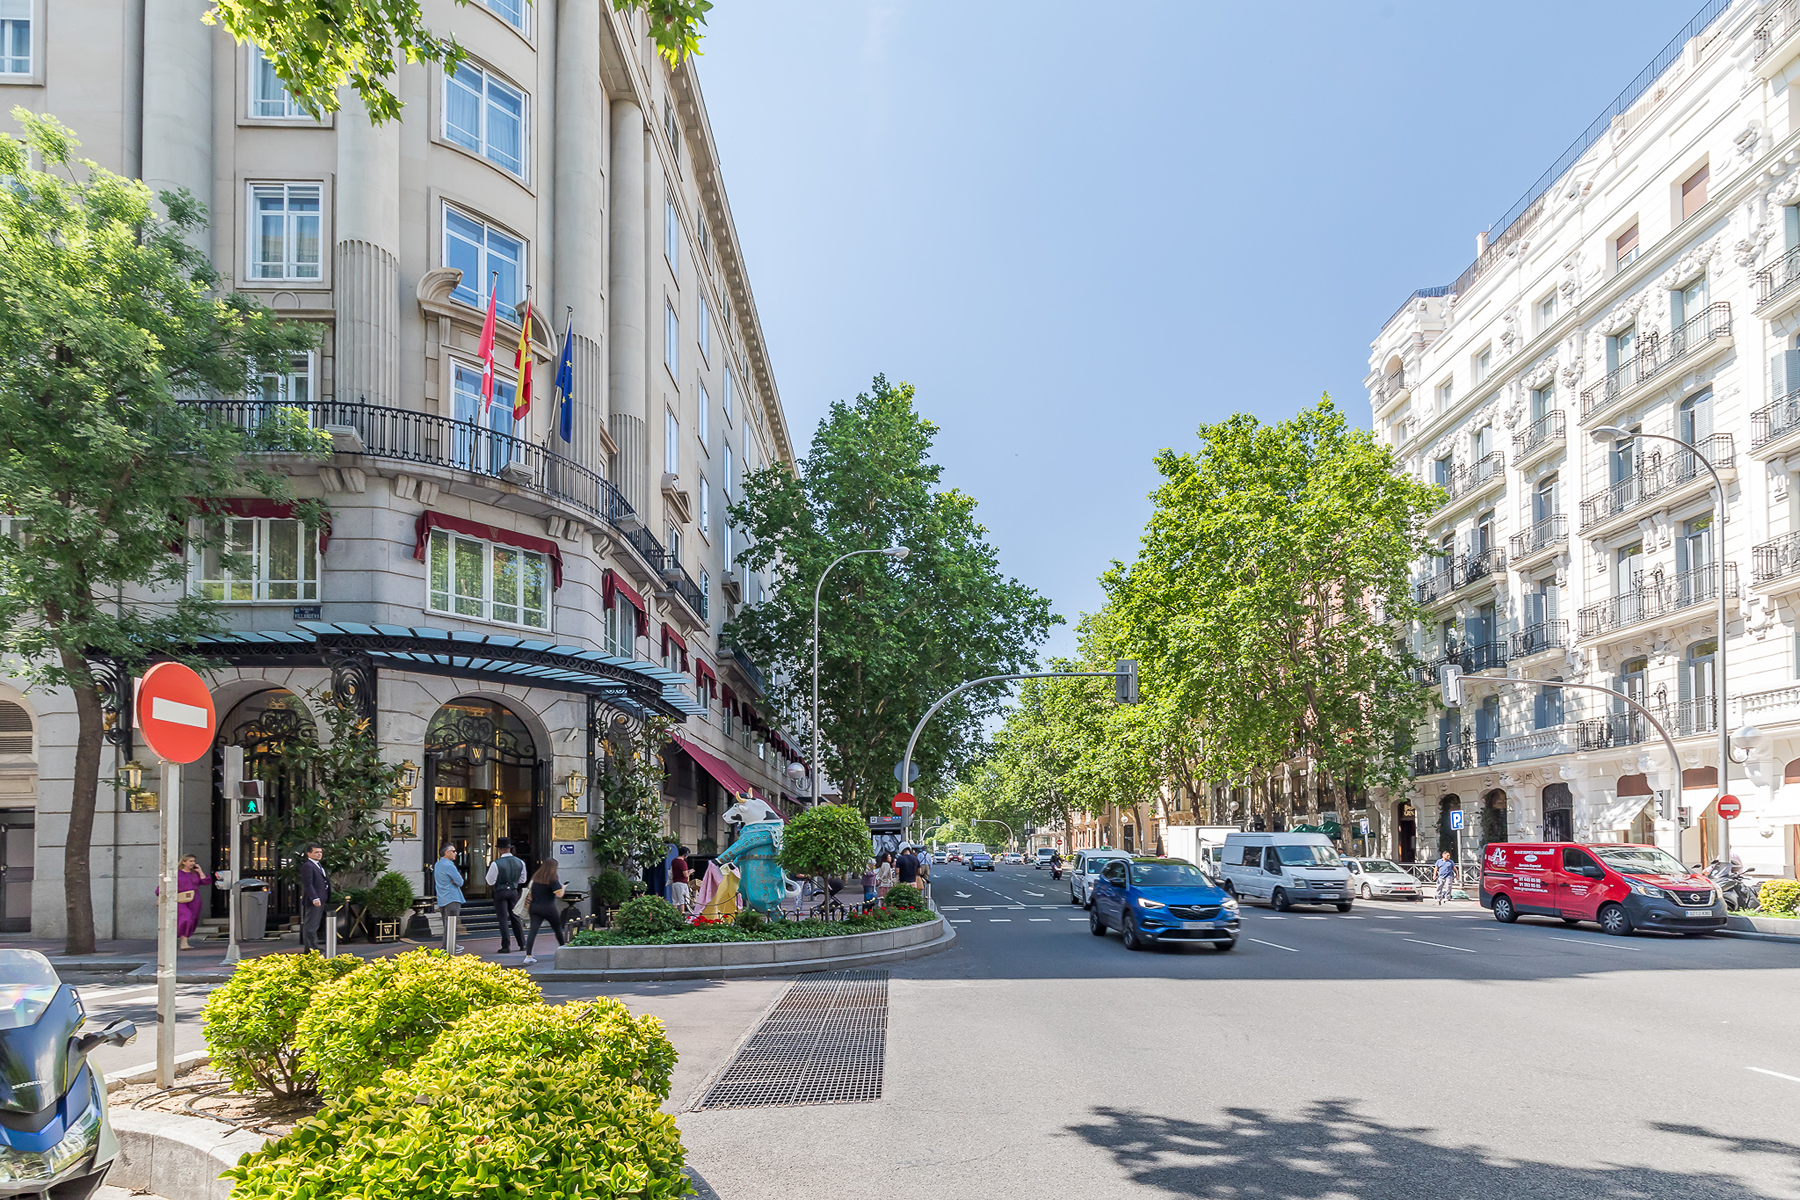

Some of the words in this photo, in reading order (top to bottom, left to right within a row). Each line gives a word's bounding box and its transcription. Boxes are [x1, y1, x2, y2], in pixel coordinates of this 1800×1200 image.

[472, 747, 483, 759] W
[1453, 813, 1461, 827] P
[383, 927, 393, 935] W
[11, 1080, 48, 1090] HONDA
